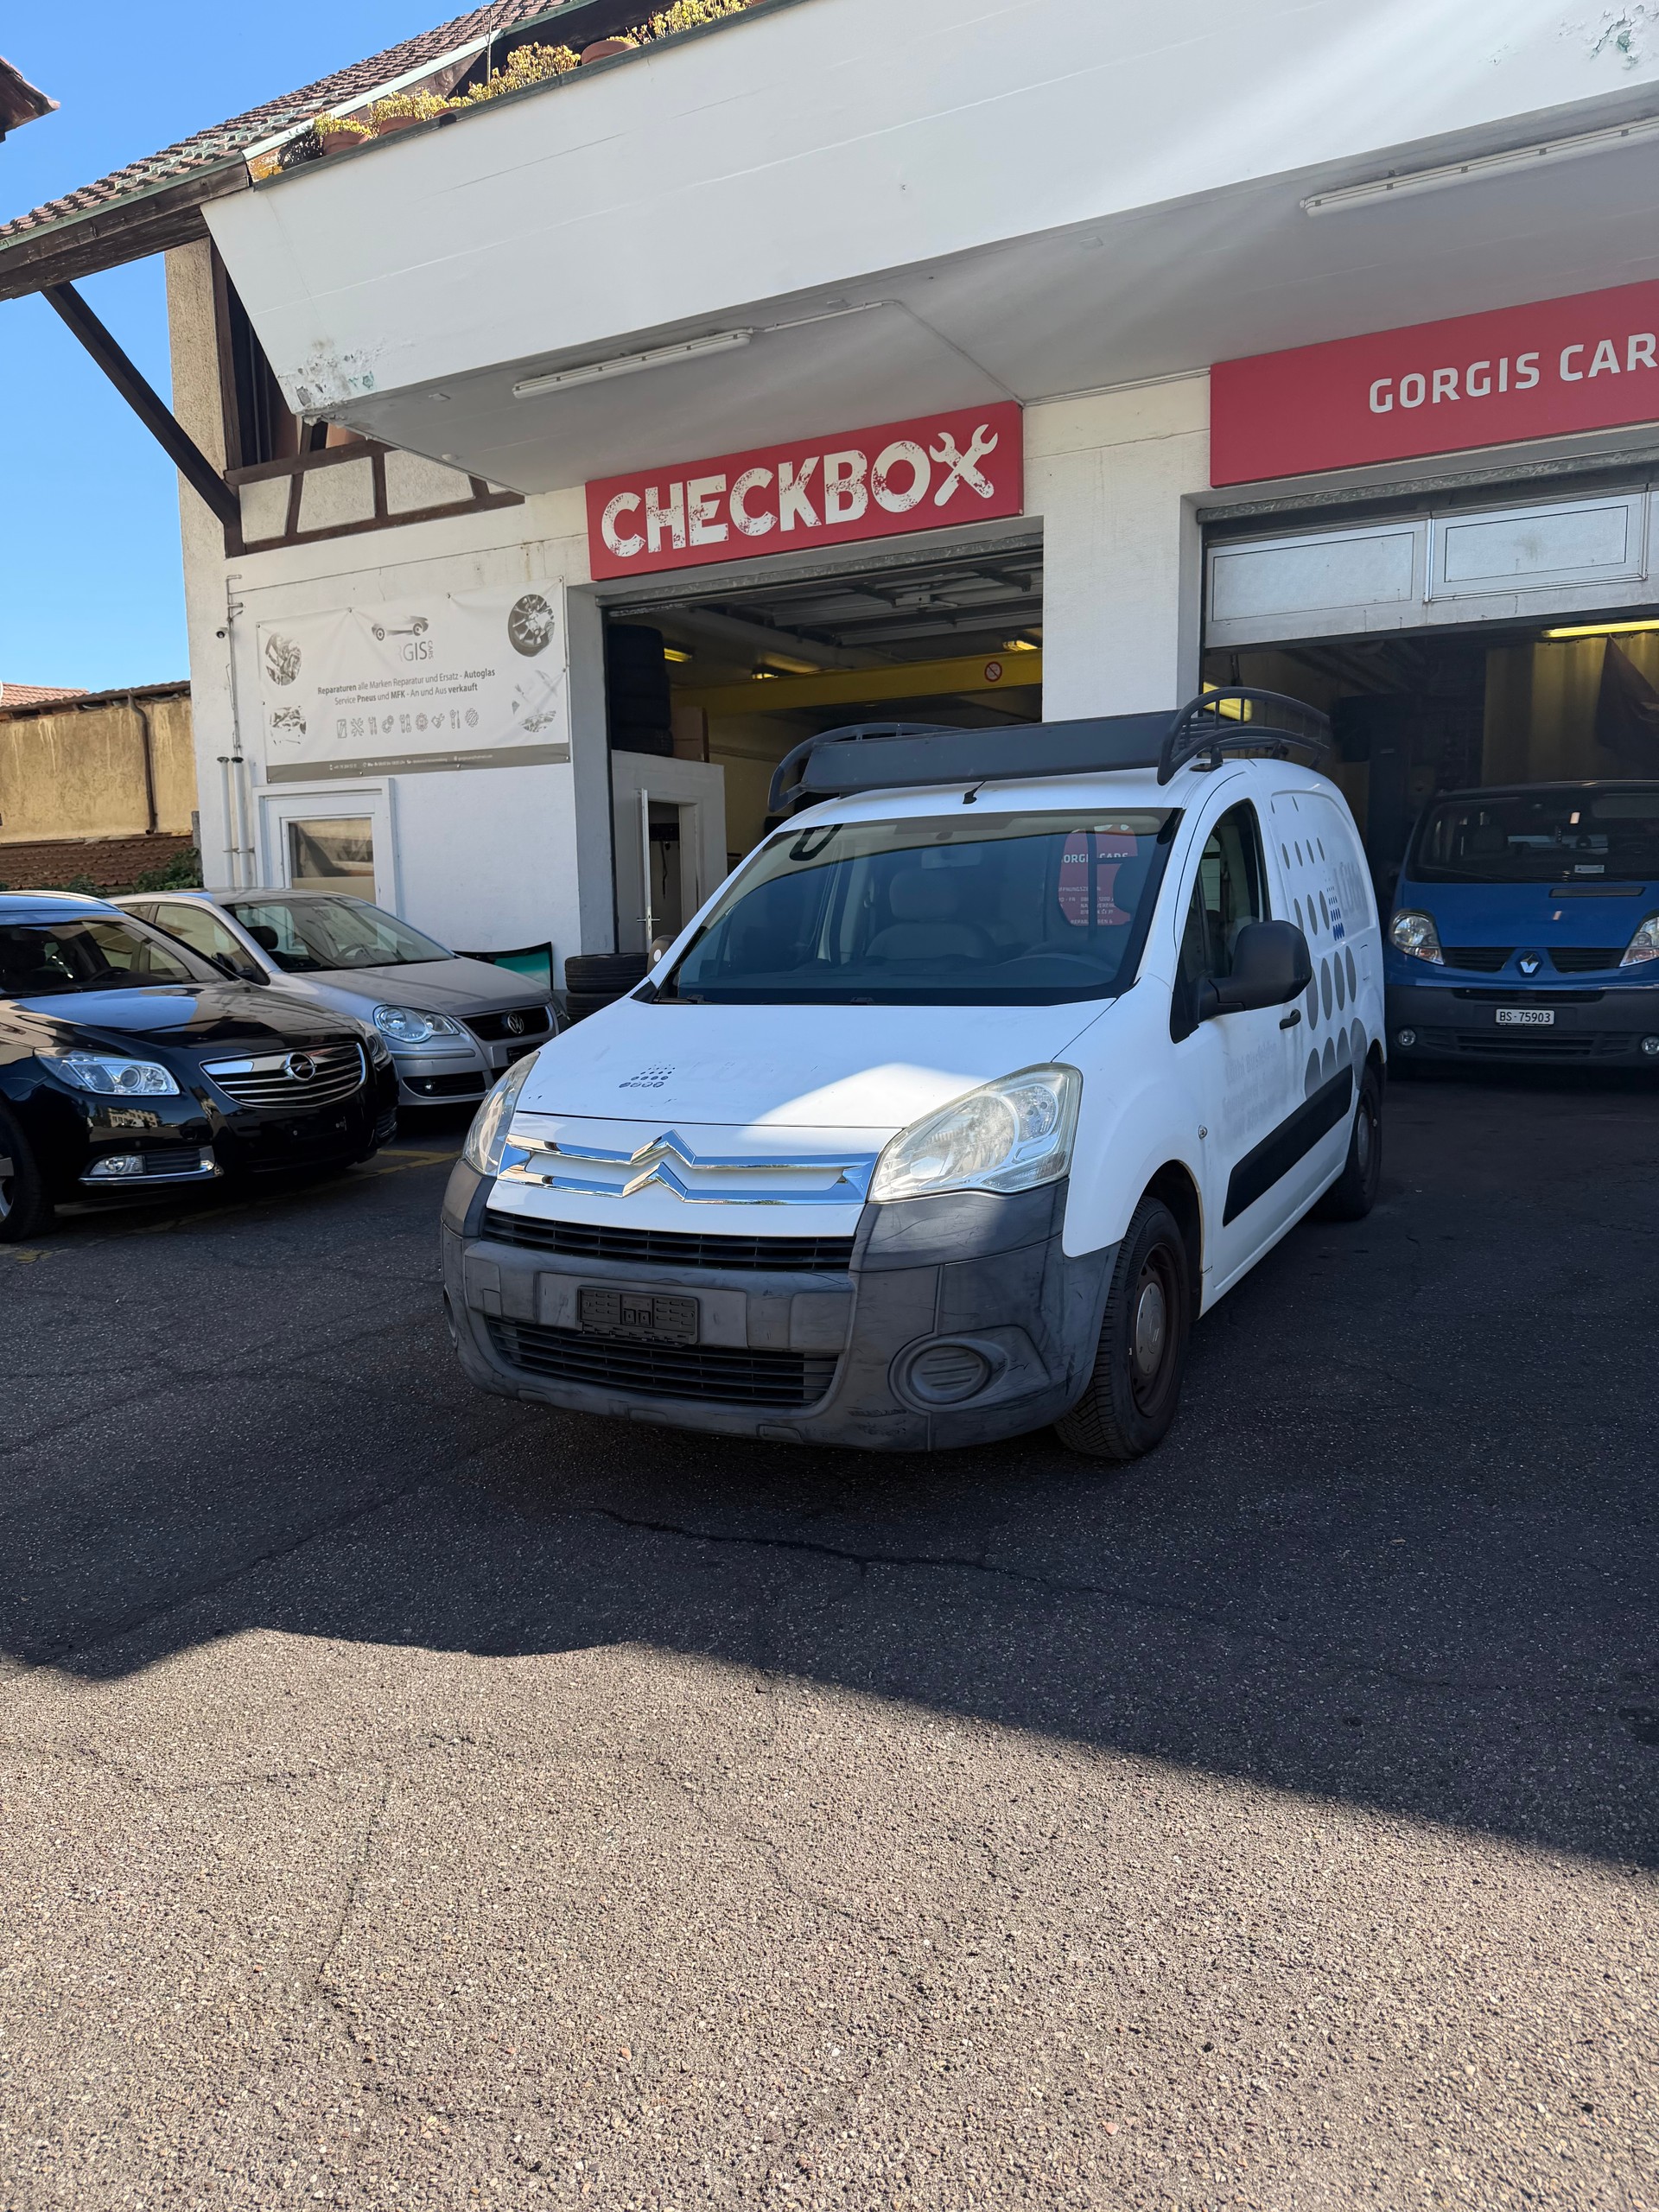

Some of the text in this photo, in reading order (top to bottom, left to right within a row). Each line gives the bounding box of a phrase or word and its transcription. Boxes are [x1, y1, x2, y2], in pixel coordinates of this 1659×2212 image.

[1370, 333, 1658, 414] GORGIS CAR
[601, 423, 998, 557] CHECKBOX
[317, 684, 357, 696] Reparaturen
[358, 682, 369, 690] alle
[369, 679, 392, 690] Marken
[393, 677, 424, 689] Reparatur
[425, 674, 438, 685] und
[439, 672, 459, 683] Ersatz
[464, 668, 496, 680] Autoglas
[334, 696, 356, 705] Service
[357, 693, 377, 703] Pneus
[377, 691, 390, 701] und
[391, 690, 405, 699] MFK
[410, 688, 420, 697] An
[420, 686, 434, 696] und
[435, 686, 448, 695] Aus
[448, 683, 478, 694] verkauft
[1061, 854, 1089, 863] ORGI
